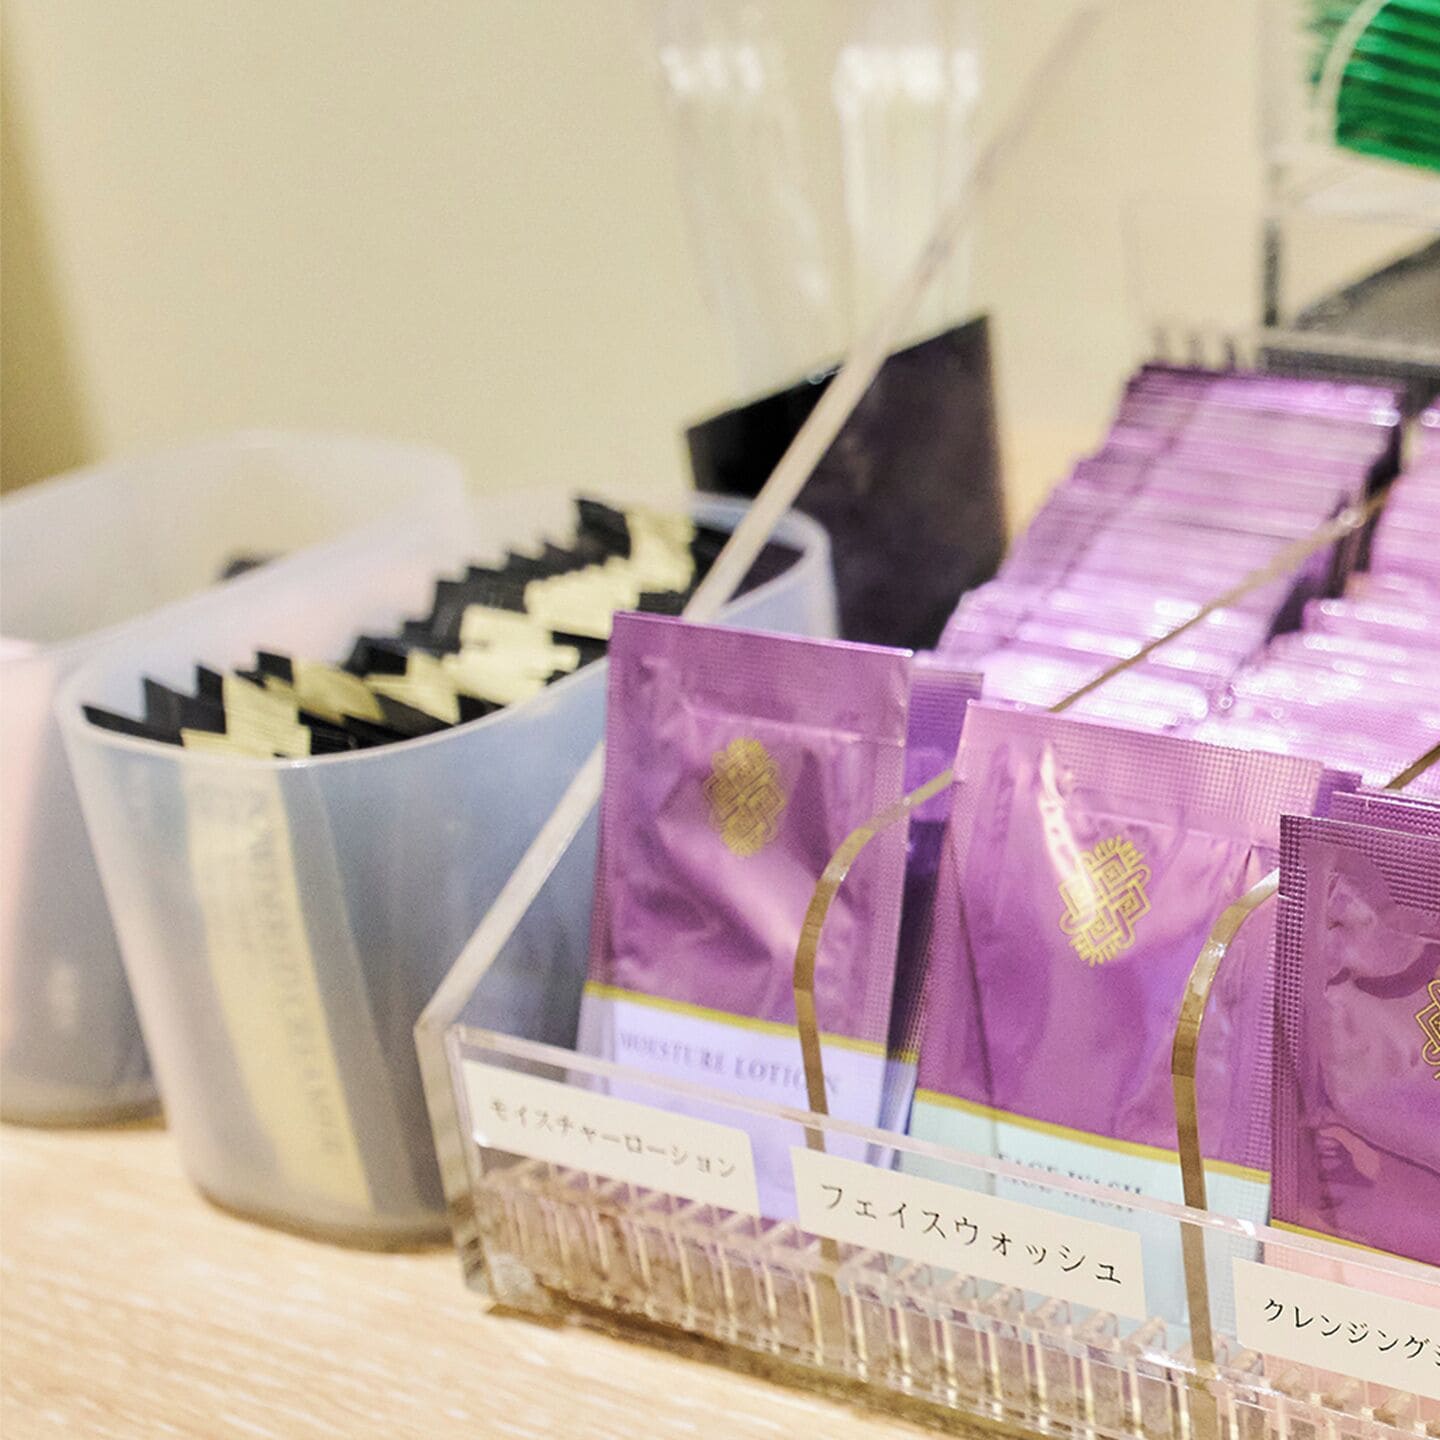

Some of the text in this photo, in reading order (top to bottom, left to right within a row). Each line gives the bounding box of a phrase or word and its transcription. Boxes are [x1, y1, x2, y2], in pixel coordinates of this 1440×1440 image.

[489, 1100, 736, 1178] モイスチャーローション
[820, 1184, 1122, 1284] フェイスウォッシュ
